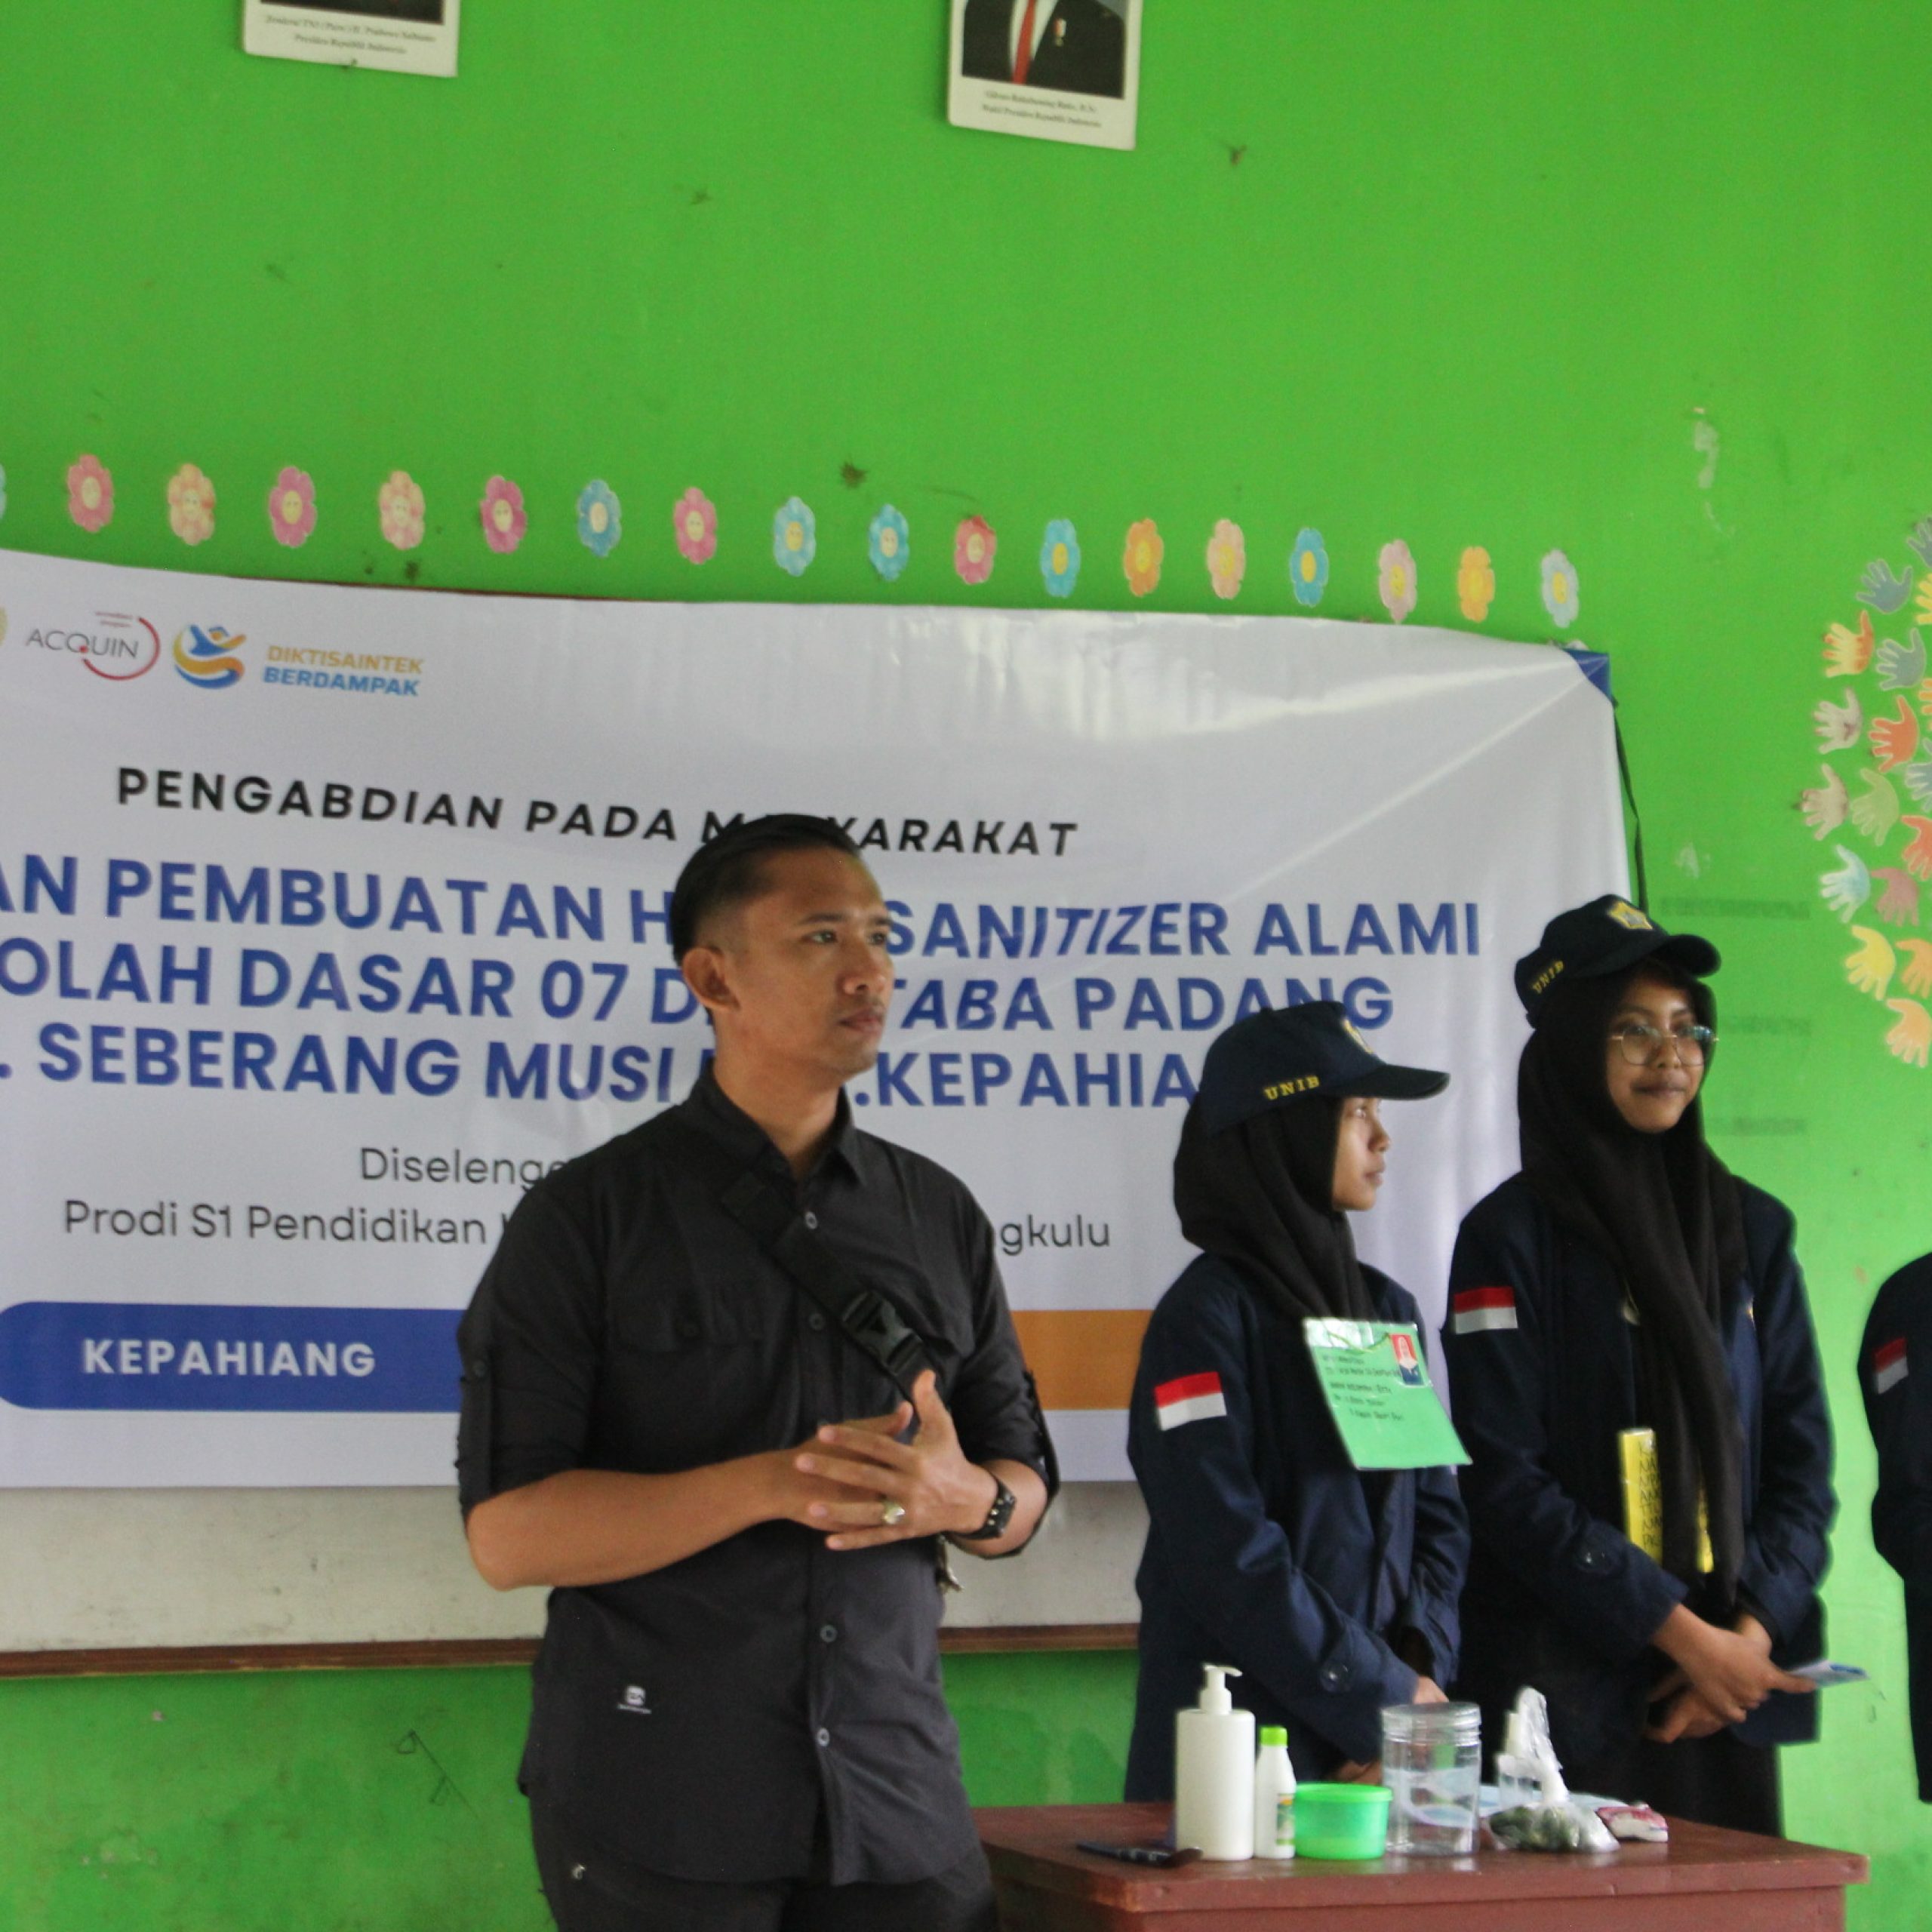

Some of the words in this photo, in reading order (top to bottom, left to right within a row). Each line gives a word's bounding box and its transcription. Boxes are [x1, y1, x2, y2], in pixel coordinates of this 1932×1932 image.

[26, 628, 139, 659] ACQUIN
[266, 645, 425, 674] DIKTISAINTEK
[263, 666, 420, 697] BERDAMPAK
[118, 767, 503, 829] PENGABDIAN
[525, 801, 677, 841] PADA
[700, 810, 1078, 857] MYARAKAT
[106, 859, 602, 942] PEMBUATAN
[884, 900, 1230, 958] SANITIZER
[1254, 903, 1479, 956] ALAMI
[239, 949, 515, 1017] DASAR
[541, 959, 628, 1022] 07
[894, 979, 1054, 1031] ABA
[38, 1022, 460, 1096] SEBERANG
[485, 1041, 674, 1103] MUSI
[854, 1052, 1200, 1108] .KEPAHIA
[1263, 1075, 1320, 1100] UNIB
[361, 1147, 565, 1191] Diseleng
[65, 1200, 178, 1237] Prodi
[192, 1204, 232, 1238] S1
[248, 1205, 487, 1244] Pendidikan
[1000, 1214, 1110, 1256] gkulu
[85, 1340, 375, 1377] KEPAHIANG
